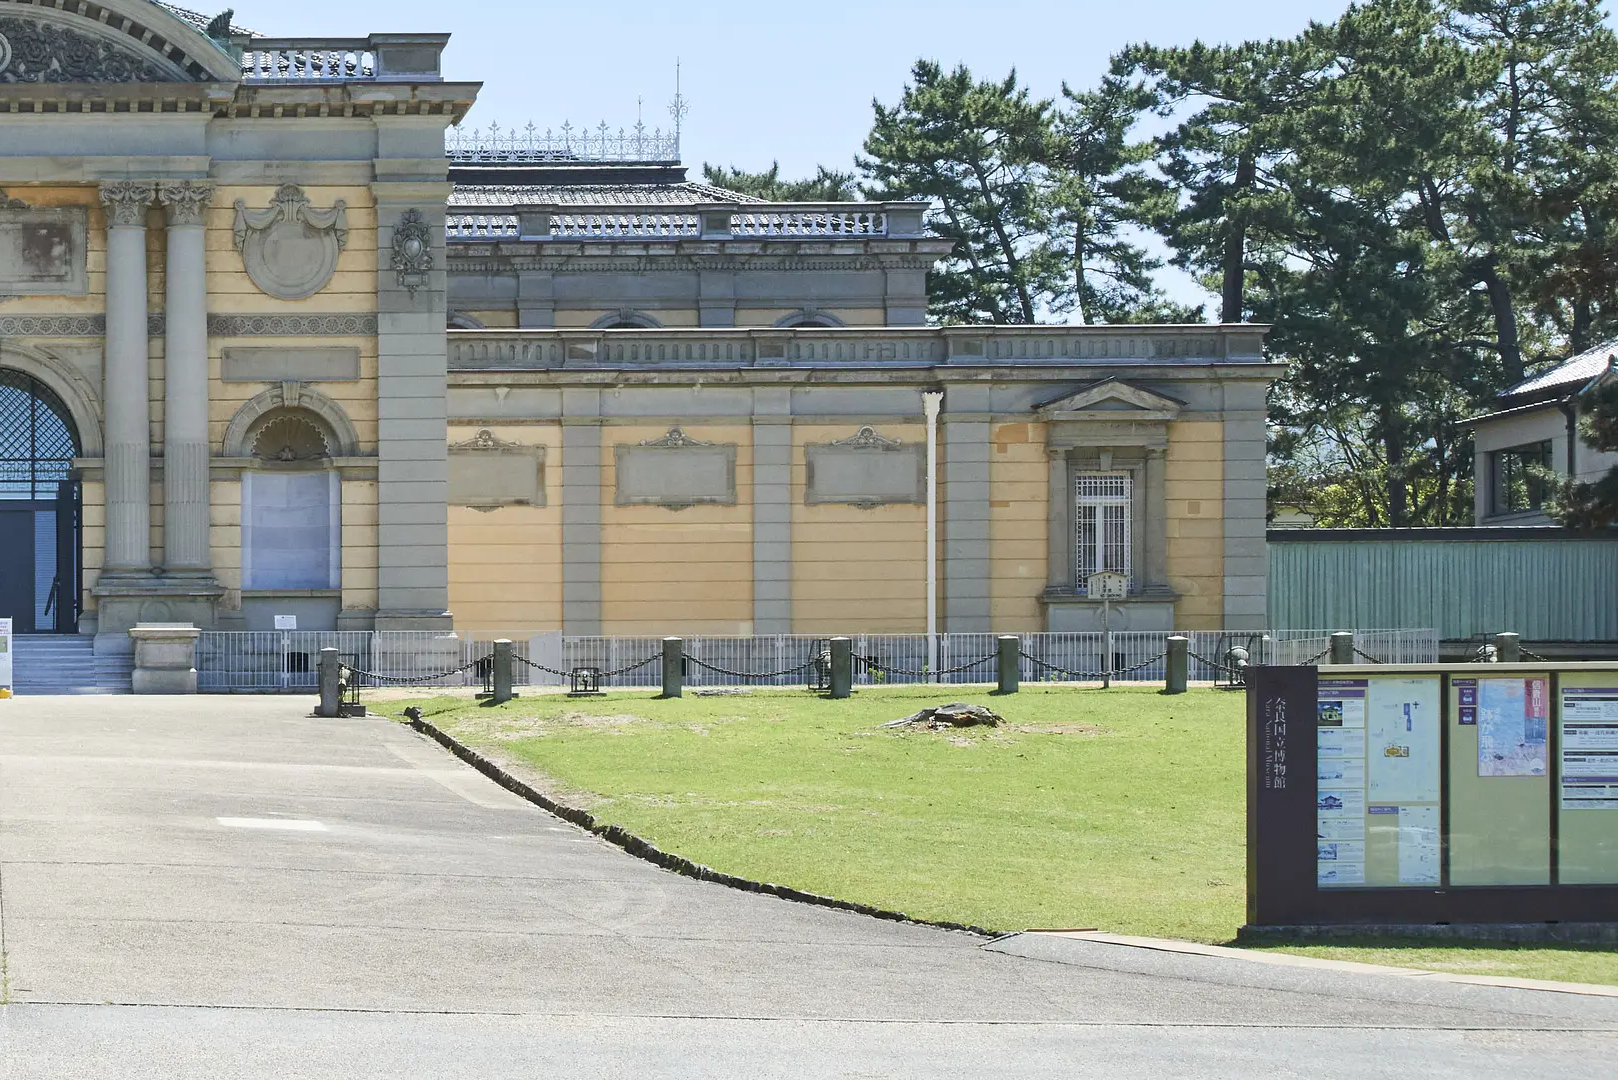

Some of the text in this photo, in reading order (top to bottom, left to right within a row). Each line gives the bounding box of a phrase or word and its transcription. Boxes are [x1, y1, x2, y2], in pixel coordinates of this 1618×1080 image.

[1265, 720, 1273, 753] National
[1274, 697, 1286, 788] 奈良国立博物館
[1265, 755, 1273, 789] Museum
